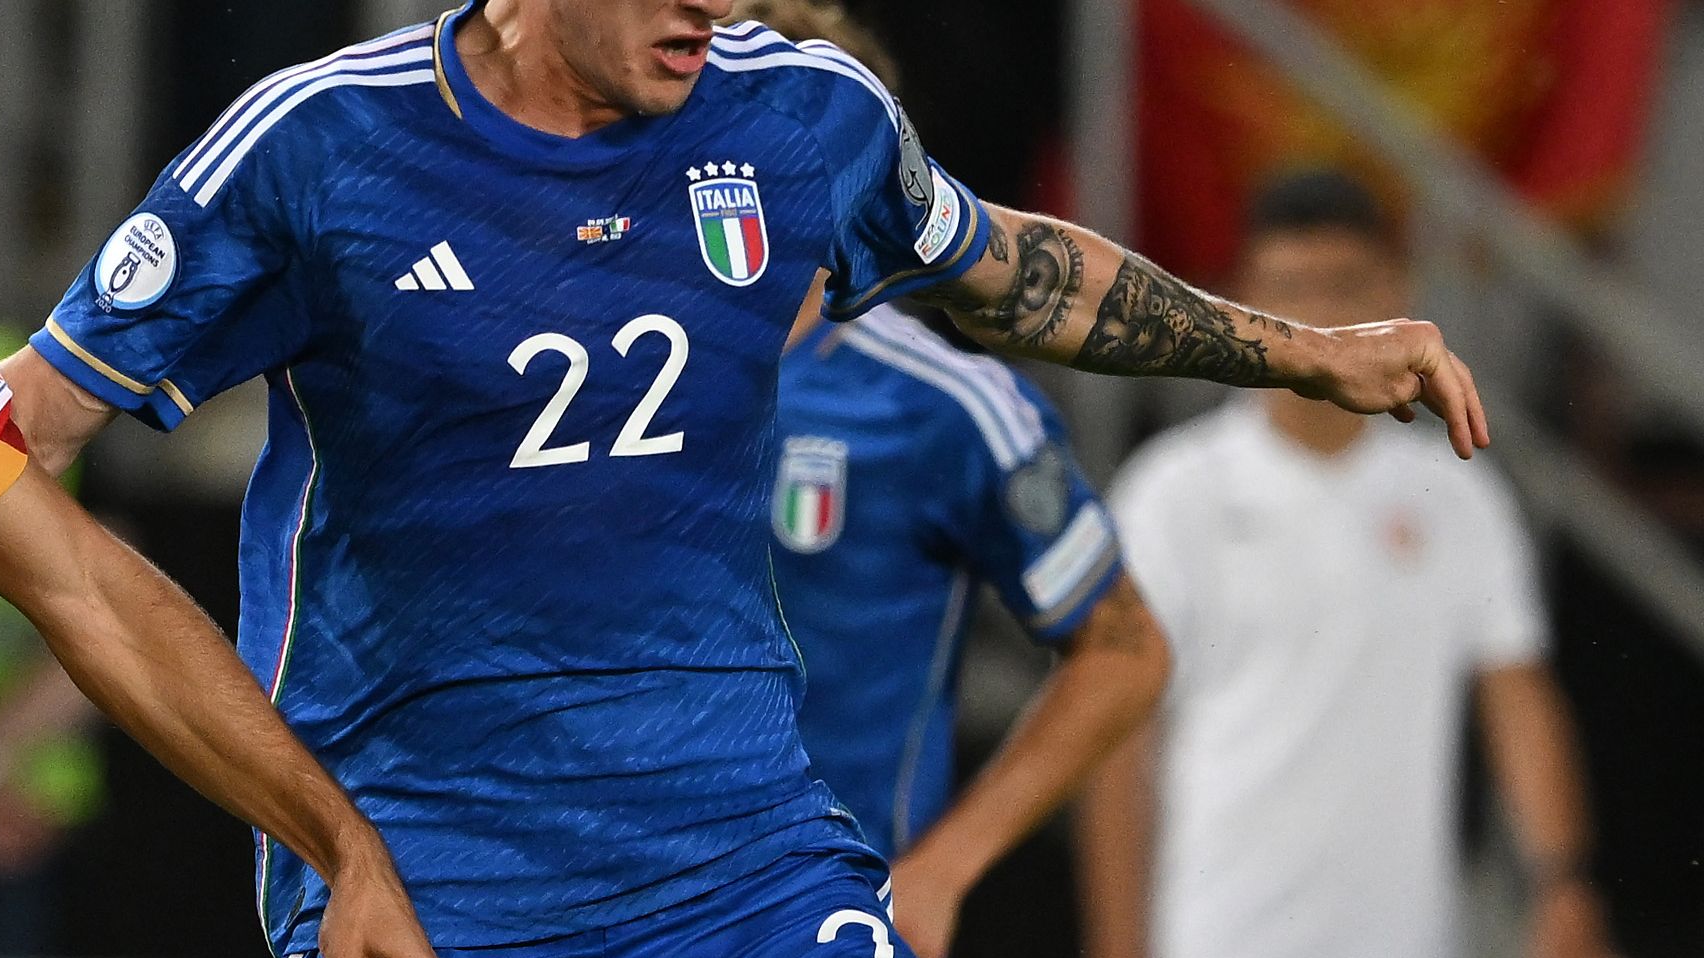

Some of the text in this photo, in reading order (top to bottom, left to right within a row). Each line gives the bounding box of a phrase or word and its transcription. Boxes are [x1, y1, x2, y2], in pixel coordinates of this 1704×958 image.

[696, 188, 755, 210] ITALIA
[130, 226, 165, 259] EUROPEAN
[144, 219, 164, 240] UEFA
[124, 235, 159, 267] CHAMPIONS
[95, 297, 111, 313] 2020
[507, 314, 689, 469] 22
